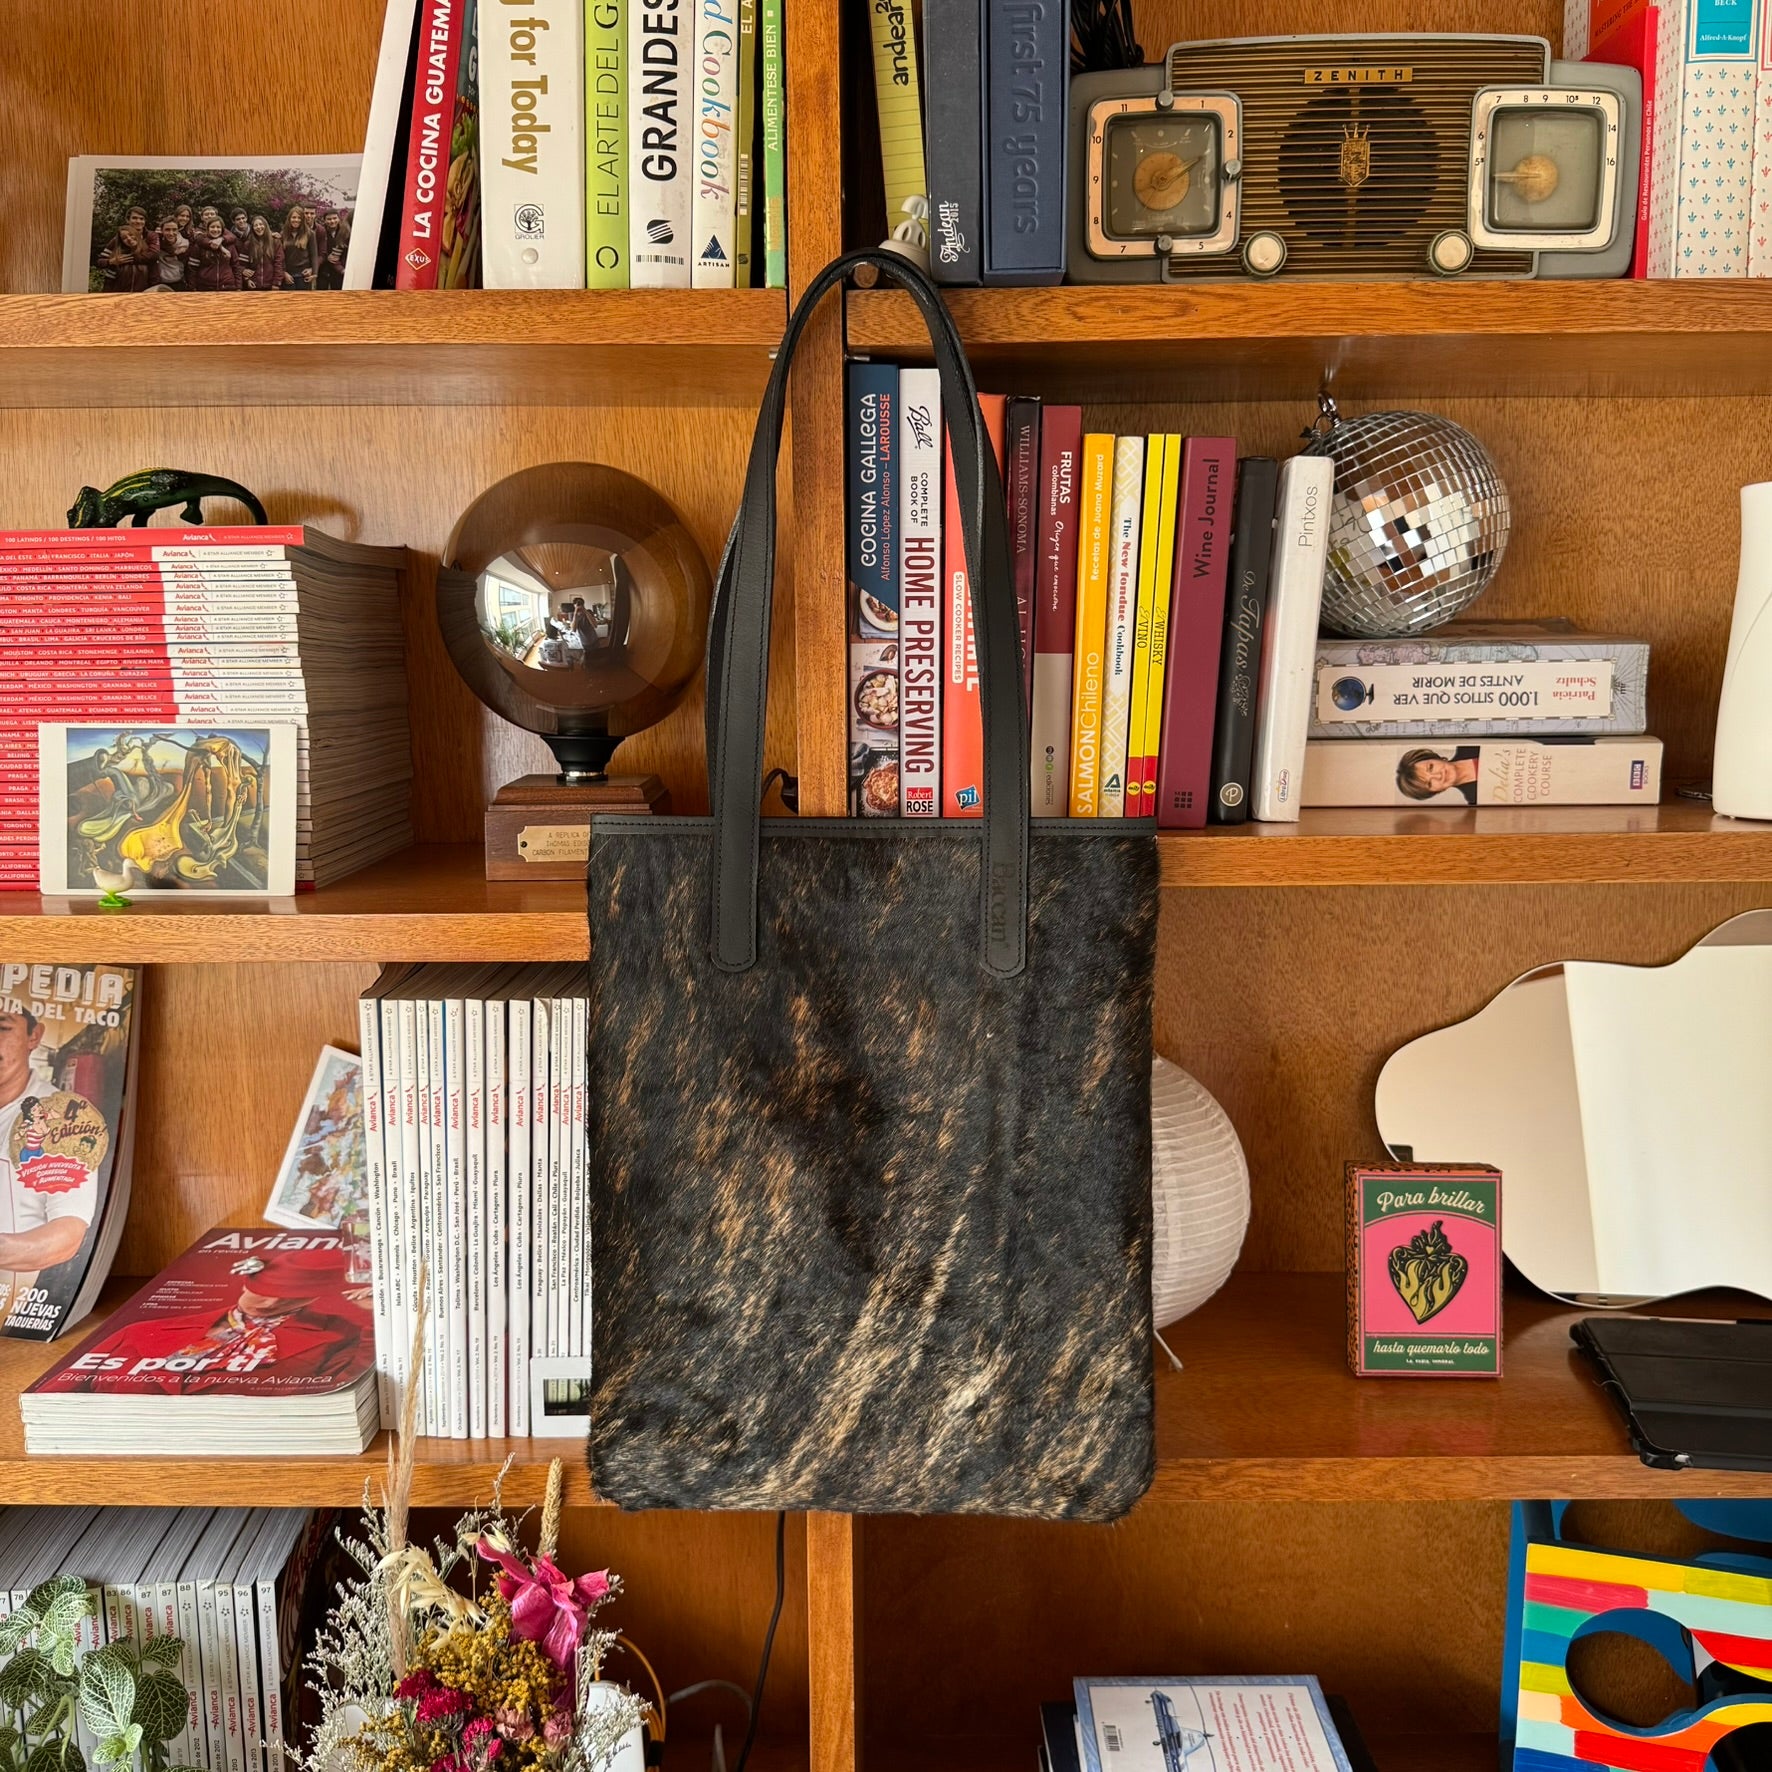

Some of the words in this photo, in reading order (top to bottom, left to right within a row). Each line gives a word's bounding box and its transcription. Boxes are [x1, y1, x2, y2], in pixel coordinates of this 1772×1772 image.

[741, 15, 753, 34] EL
[509, 17, 551, 66] for
[766, 24, 777, 59] BIEN
[1002, 2, 1045, 76] first
[596, 38, 619, 95] DEL
[1313, 69, 1404, 81] ZENITH
[766, 62, 779, 152] ALIMENTESE
[1012, 82, 1044, 123] 75
[1121, 103, 1128, 113] 11
[1200, 100, 1205, 109] 1
[1495, 95, 1502, 104] 7
[1523, 94, 1529, 104] 8
[1542, 94, 1549, 104] 9
[1592, 96, 1602, 105] 12
[501, 75, 552, 175] Today
[700, 29, 734, 201] Cookbook
[1607, 124, 1617, 133] 14
[596, 103, 619, 178] ARTE
[1091, 135, 1102, 145] 10
[1227, 129, 1234, 139] 2
[1478, 131, 1485, 141] 6
[416, 112, 442, 204] COCINA
[1606, 157, 1616, 167] 16
[1002, 134, 1039, 234] years
[1092, 175, 1099, 184] 9
[597, 184, 619, 216] EL
[950, 202, 959, 223] 2015
[412, 211, 432, 239] LA
[1092, 216, 1100, 225] 8
[1225, 210, 1233, 220] 4
[937, 200, 962, 263] Andean
[1198, 241, 1205, 250] 5
[1120, 245, 1127, 254] 7
[879, 393, 891, 461] LAROUSSE
[905, 405, 934, 450] Ball
[1059, 451, 1073, 504] FRUTAS
[1095, 454, 1105, 491] Muzard
[880, 472, 890, 506] Alonso
[910, 475, 918, 506] BOOK
[920, 472, 929, 528] COMPLETE
[1016, 425, 1031, 554] WILLIAMS-SONOMA
[1050, 465, 1059, 516] colombianas
[1198, 457, 1219, 526] Journal
[910, 509, 919, 524] OF
[1093, 493, 1103, 525] Juana
[1297, 485, 1318, 548] Pintxos
[182, 533, 210, 541] Avianca
[859, 490, 877, 567] COCINA
[880, 507, 892, 540] López
[1094, 526, 1102, 540] de
[1122, 517, 1132, 538] The
[880, 543, 890, 581] Alfonso
[1090, 544, 1100, 581] Recetas
[1120, 542, 1131, 568] New
[1193, 531, 1213, 579] Wine
[904, 537, 935, 609] HOME
[1242, 570, 1257, 592] De
[954, 574, 963, 601] SLOW
[1117, 572, 1130, 621] fondue
[954, 602, 964, 641] COOKER
[1136, 621, 1149, 649] VINO
[1229, 595, 1261, 672] Tapas
[1114, 625, 1125, 676] Cookbook
[1153, 619, 1166, 666] WHISKY
[954, 643, 963, 681] RECIPES
[1412, 676, 1456, 688] MORIR
[1459, 676, 1476, 687] DE
[1479, 675, 1524, 687] ANTES
[1555, 676, 1597, 687] Schultz
[904, 620, 935, 774] PRESERVING
[1393, 693, 1419, 705] VER
[1422, 690, 1451, 705] QUE
[1453, 692, 1494, 704] SITIOS
[1499, 691, 1539, 706] 1.000
[1552, 690, 1596, 701] Patricia
[1077, 652, 1100, 814] SALMONChileno
[1488, 749, 1511, 802] Delia's
[1513, 748, 1526, 803] COMPLETE
[1527, 751, 1539, 801] COOKERY
[1540, 755, 1553, 796] COURSE
[906, 801, 934, 813] ROSE
[907, 787, 933, 800] Robert
[959, 791, 978, 804] pil
[0, 963, 124, 1009] PEDIA
[31, 1001, 66, 1020] DEL
[74, 1006, 120, 1028] TACO
[369, 1101, 378, 1132] Avianca
[1376, 1189, 1425, 1213] Para
[1427, 1186, 1486, 1214] brillar
[15, 1286, 49, 1303] 200
[4, 1315, 55, 1331] TAQUERÍAS
[10, 1301, 62, 1319] NUEVAS
[1372, 1340, 1406, 1353] hasta
[1406, 1340, 1461, 1356] quemarlo
[1462, 1341, 1490, 1354] todo
[69, 1352, 127, 1371] Es
[127, 1355, 220, 1375] por
[225, 1352, 263, 1372] ti
[57, 1372, 165, 1384] Bienvenidos
[168, 1375, 179, 1384] a
[183, 1374, 201, 1384] la
[204, 1375, 260, 1385] nueva
[261, 1374, 334, 1385] Avianca
[179, 1584, 191, 1592] 88
[217, 1589, 229, 1597] 95
[237, 1589, 249, 1597] 96
[260, 1586, 272, 1594] 97
[228, 1696, 237, 1738] Avianca
[247, 1697, 256, 1738] Avianca
[269, 1693, 278, 1735] Avianca
